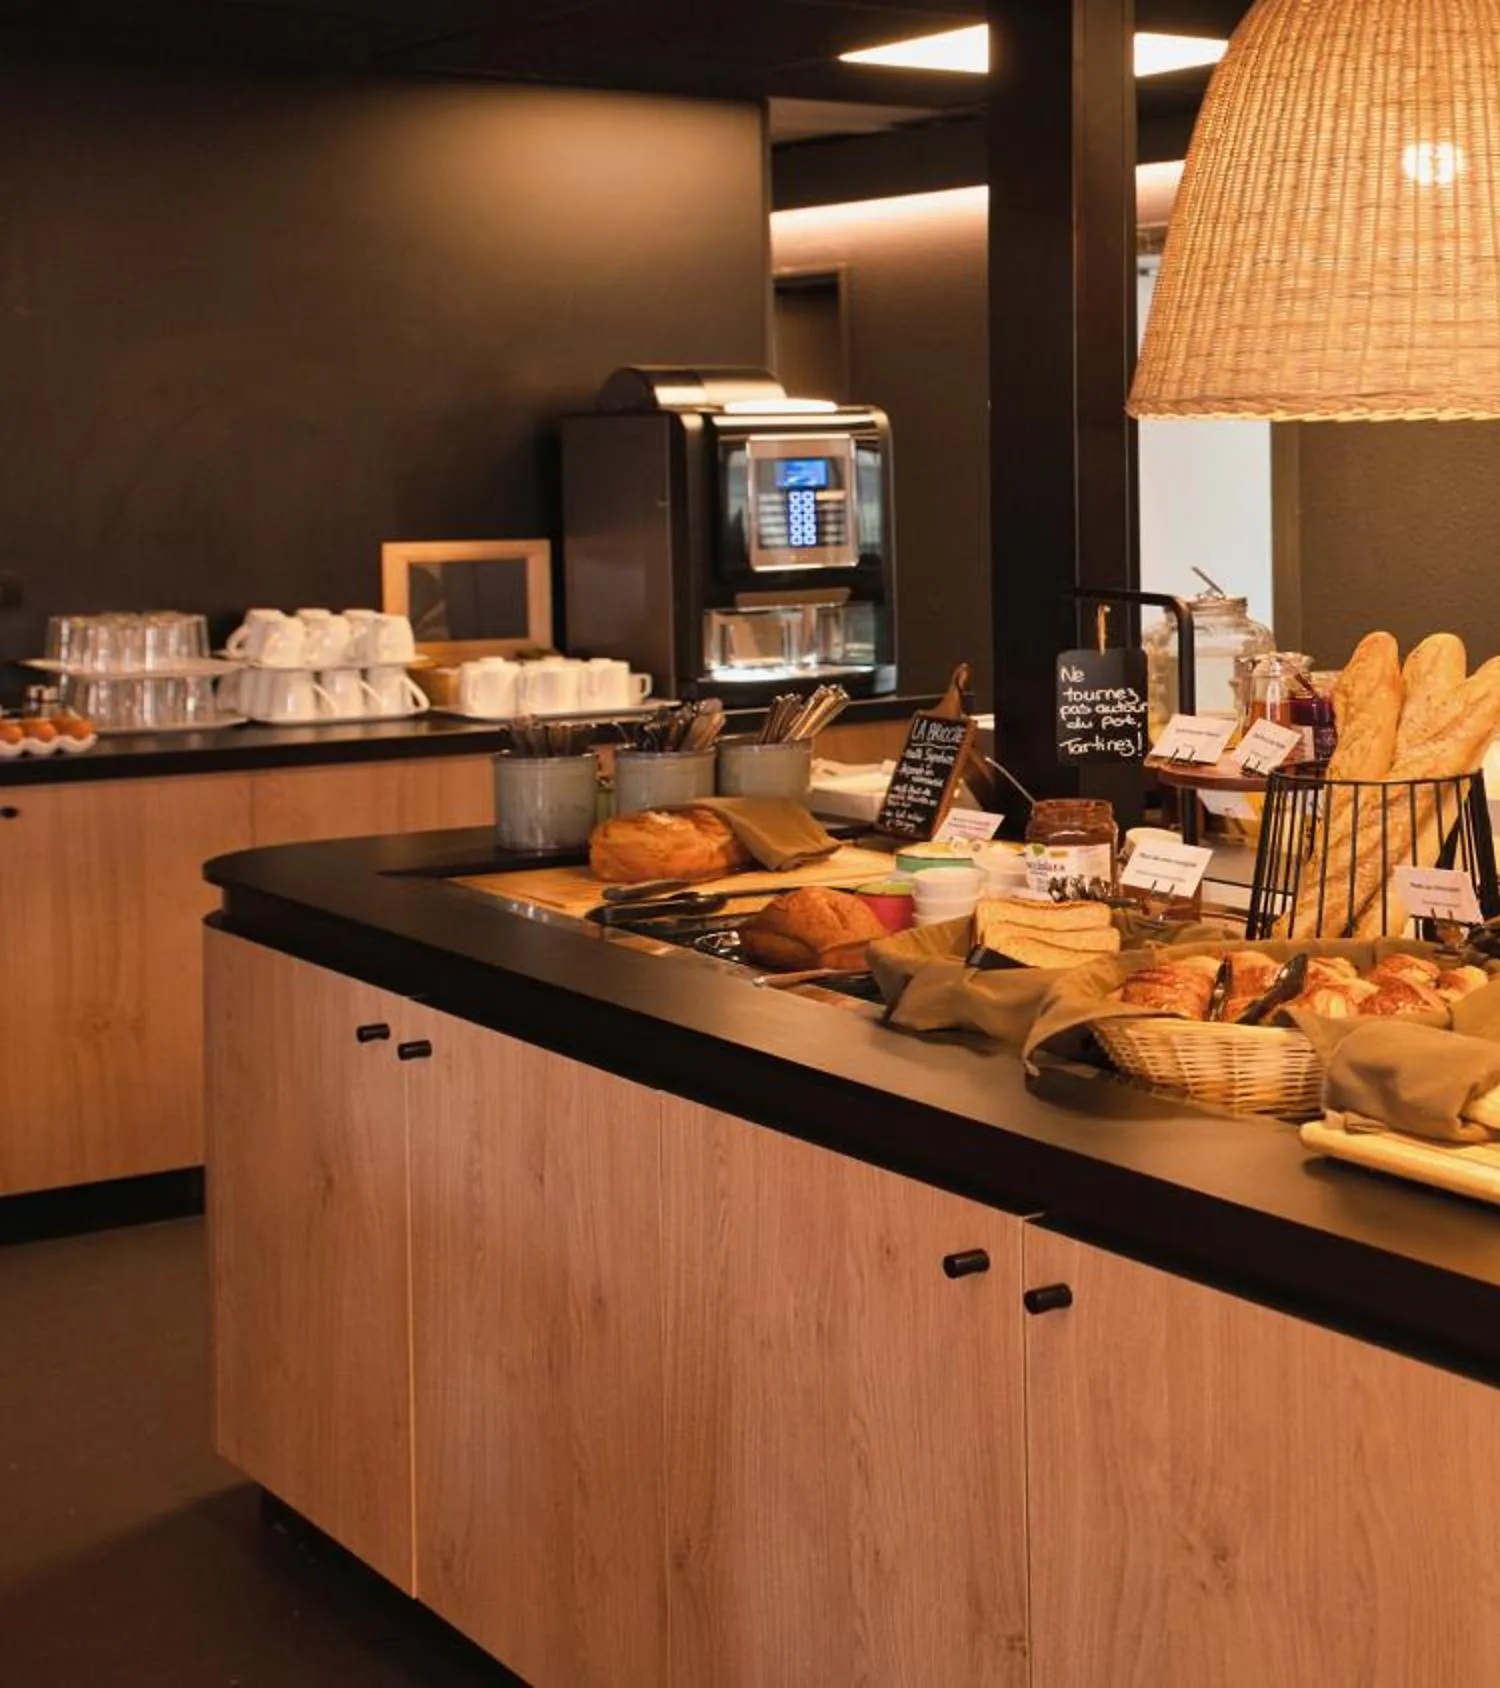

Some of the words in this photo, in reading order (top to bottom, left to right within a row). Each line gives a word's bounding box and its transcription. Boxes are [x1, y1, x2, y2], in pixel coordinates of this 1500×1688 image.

[1060, 665, 1085, 682] Ne
[1062, 687, 1140, 705] tournez
[1060, 703, 1092, 720] pas
[1095, 701, 1148, 714] autour
[1066, 716, 1093, 729] du
